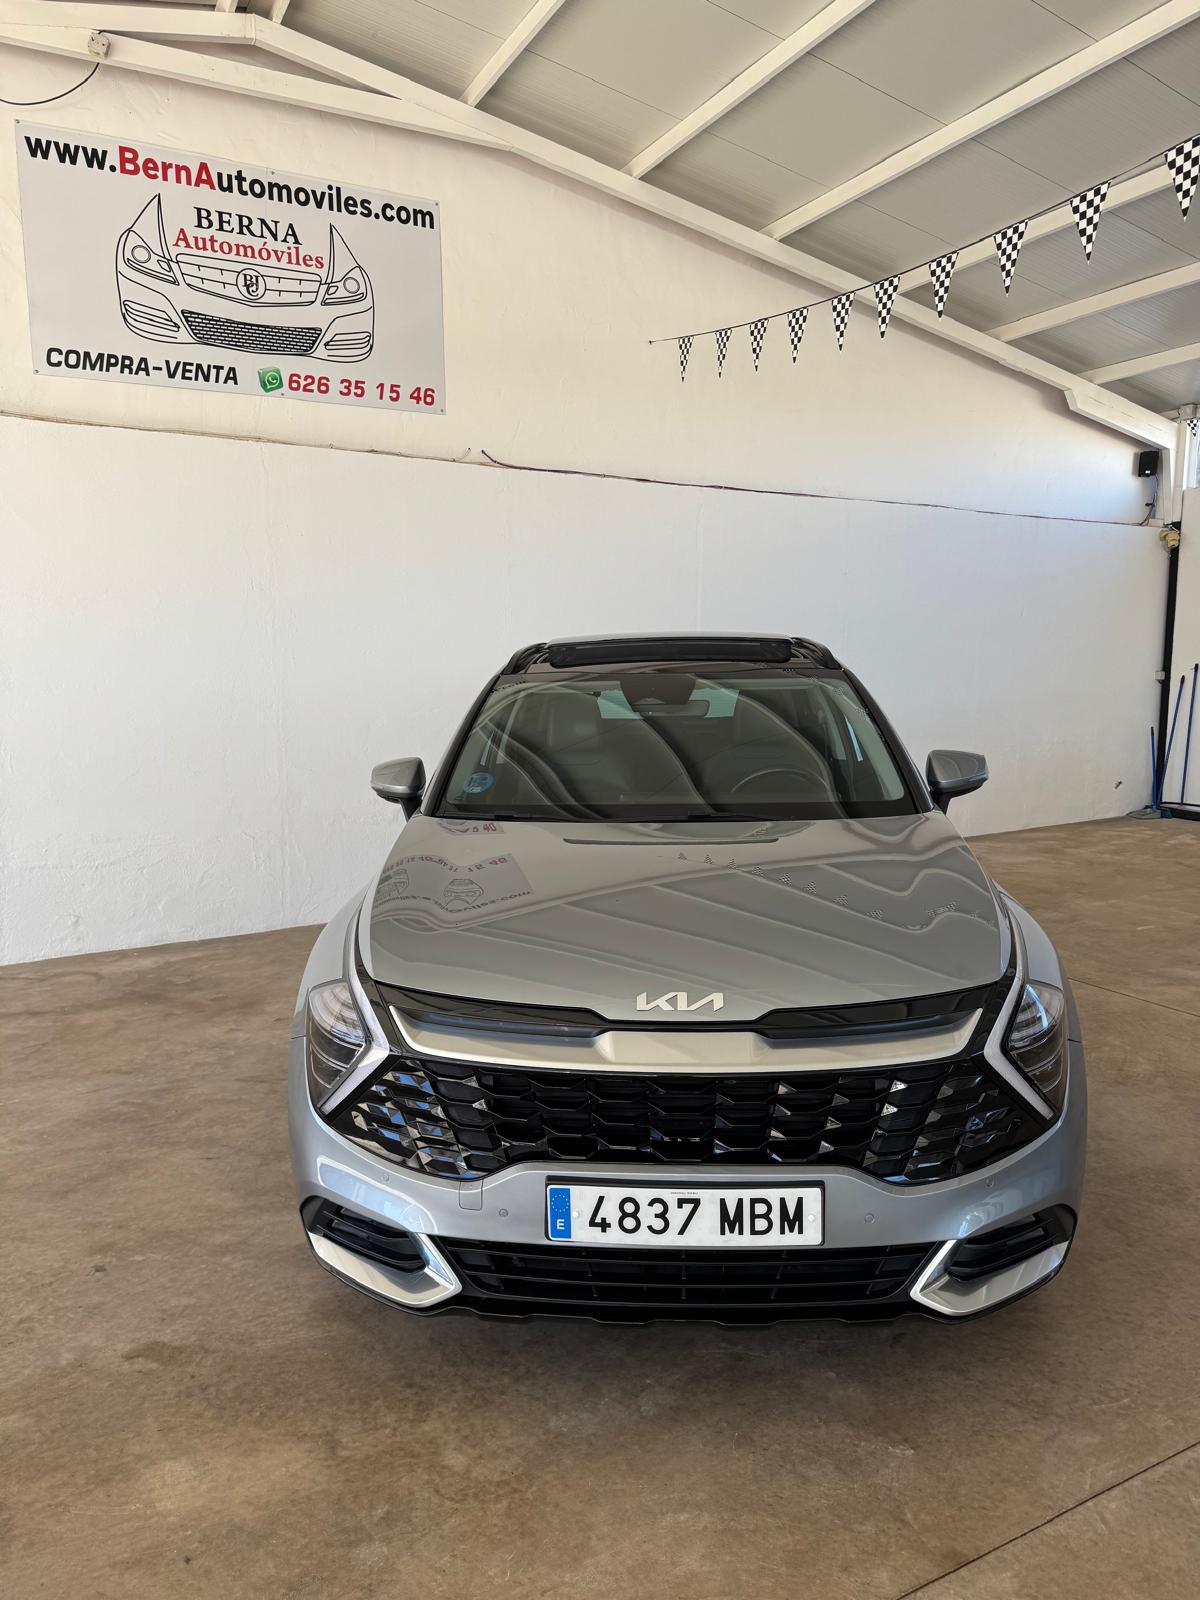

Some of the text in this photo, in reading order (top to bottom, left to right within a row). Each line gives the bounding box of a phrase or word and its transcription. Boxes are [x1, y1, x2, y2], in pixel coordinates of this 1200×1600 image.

[24, 136, 435, 230] www.BernAutomoviles.com
[193, 206, 303, 246] BERNA
[173, 228, 325, 270] Automóviles
[46, 347, 239, 386] COMPRA-VENTA
[288, 373, 435, 407] 626 35 15 46
[637, 992, 724, 1011] KIA
[556, 1219, 565, 1230] E
[588, 1195, 804, 1236] 4837 MBM
